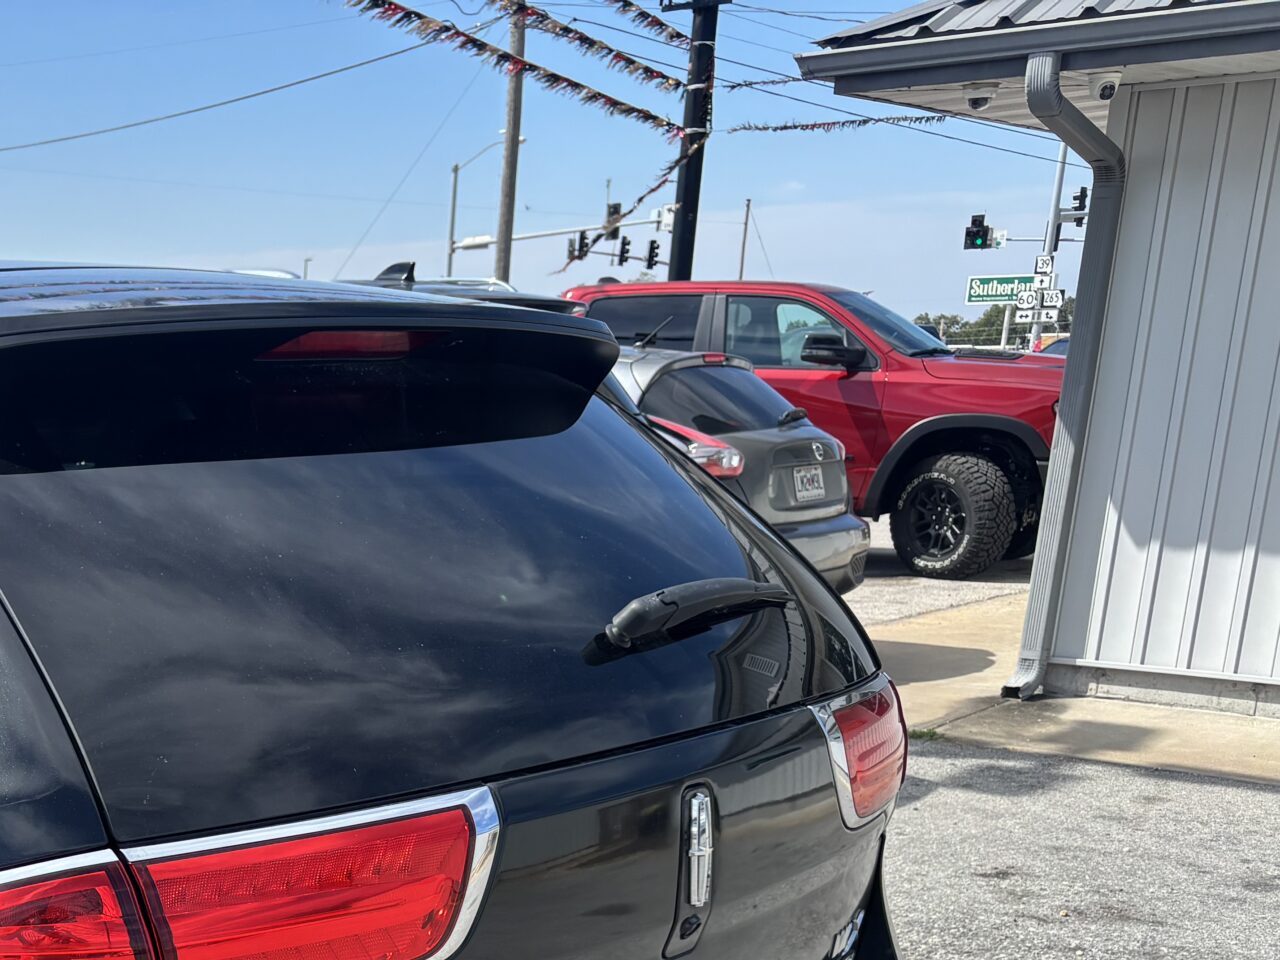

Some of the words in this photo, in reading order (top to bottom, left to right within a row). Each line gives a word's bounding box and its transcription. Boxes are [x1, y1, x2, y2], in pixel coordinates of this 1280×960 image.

[1038, 258, 1051, 270] 39
[970, 279, 1035, 296] Sutherlan
[1018, 294, 1034, 305] 60
[1044, 292, 1060, 303] 265
